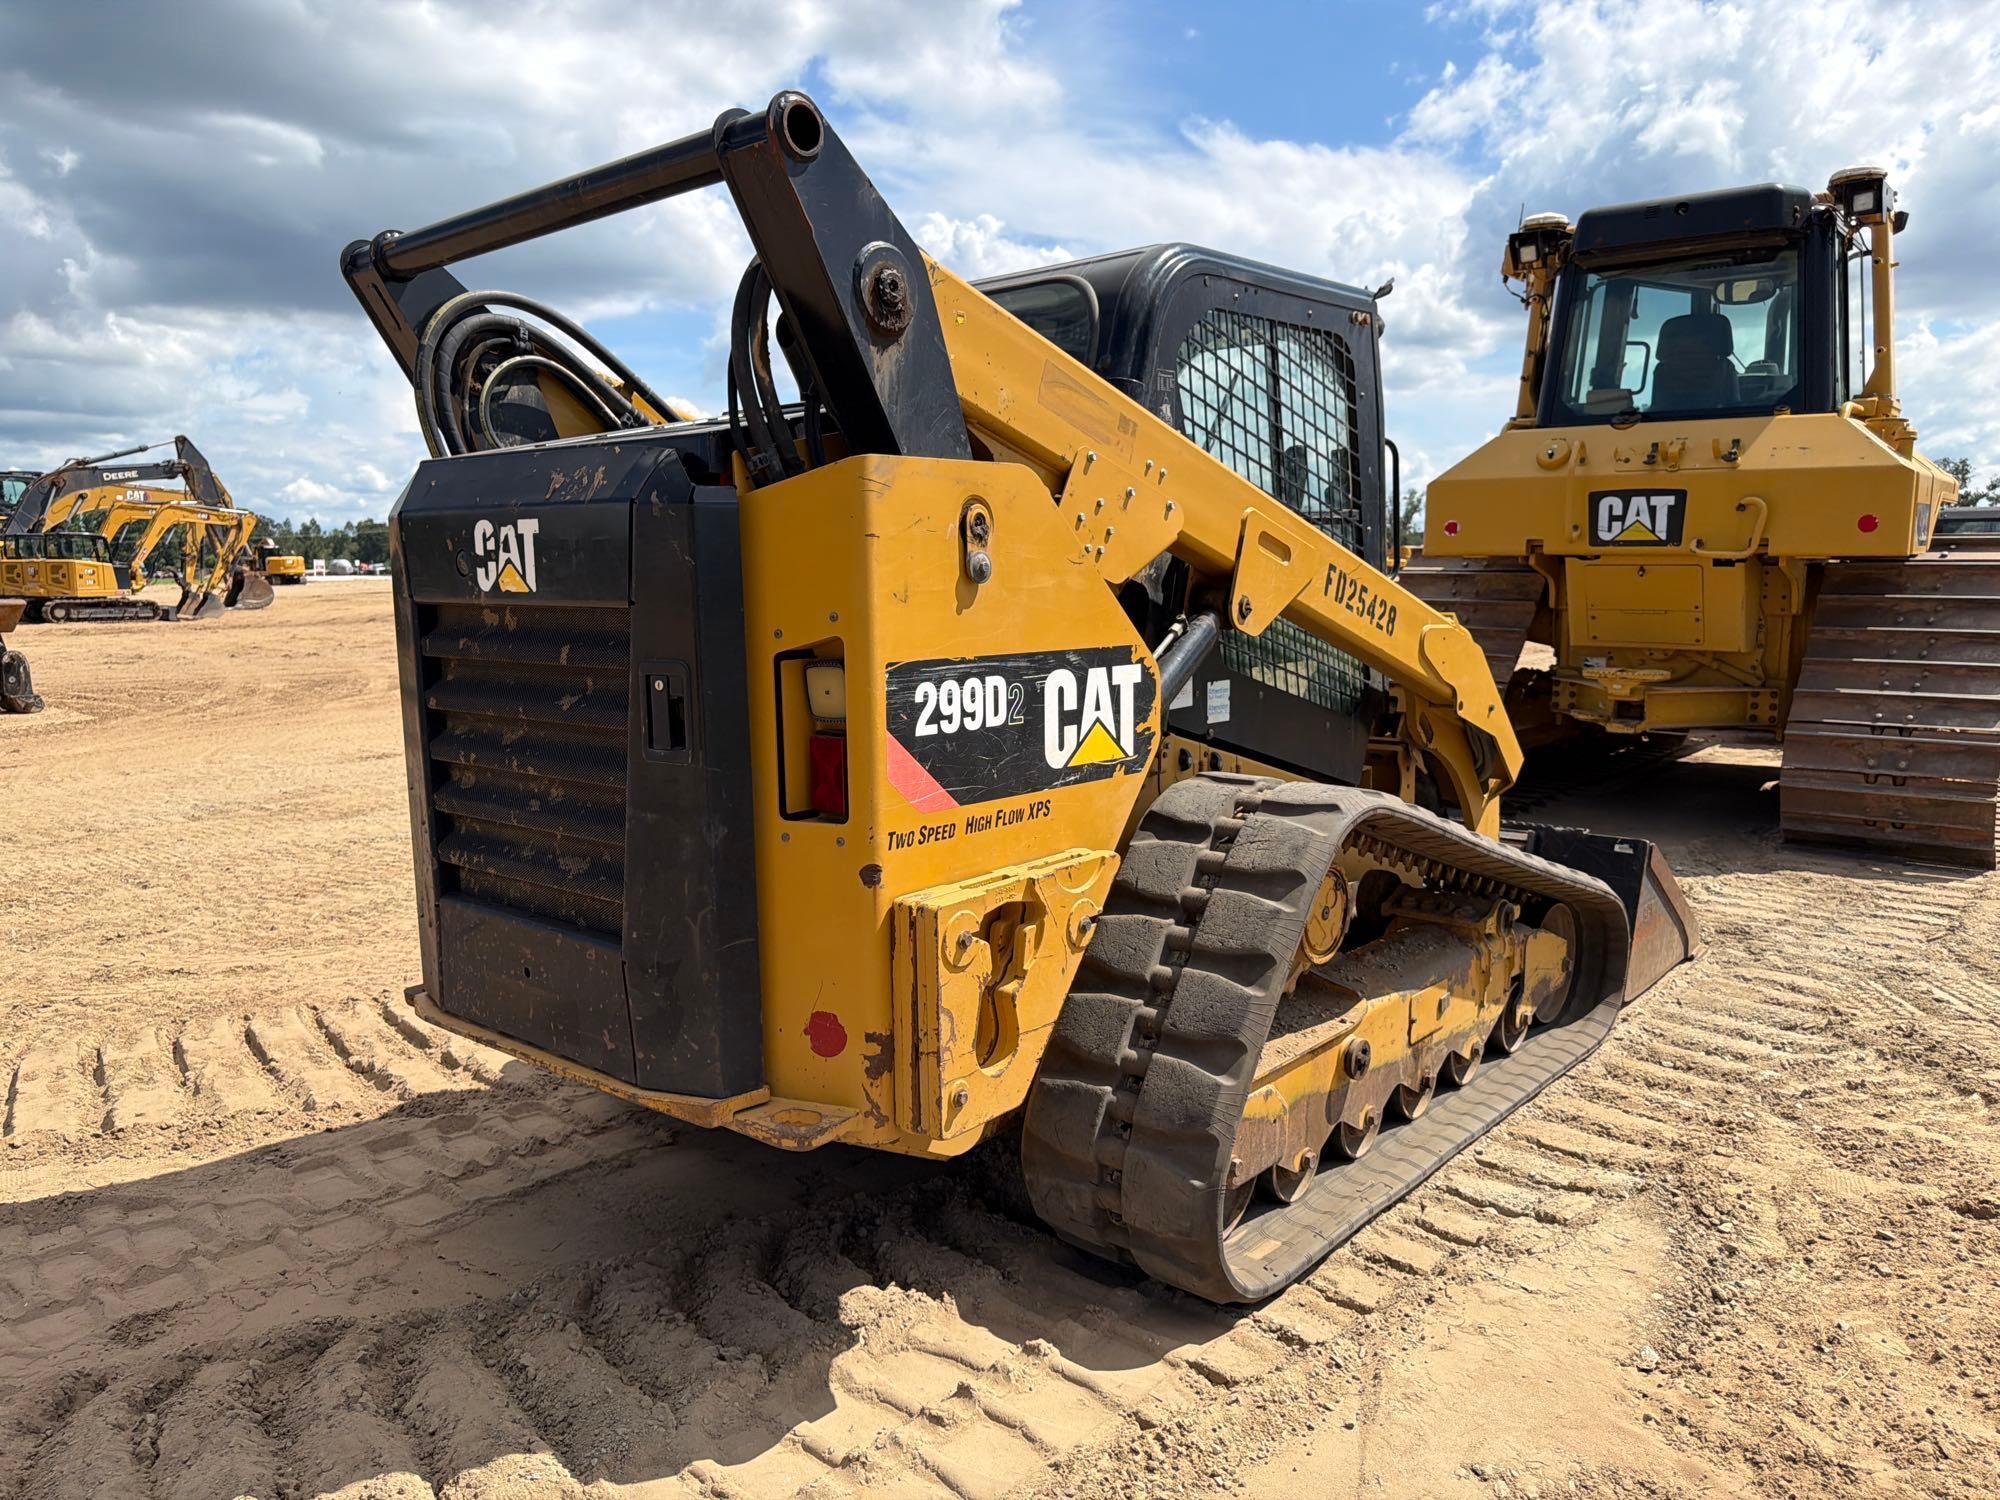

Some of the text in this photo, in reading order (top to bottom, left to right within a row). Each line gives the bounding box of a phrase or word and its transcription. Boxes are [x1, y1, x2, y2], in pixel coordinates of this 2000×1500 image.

[103, 470, 139, 481] DEERE
[126, 490, 145, 502] CAT
[1597, 495, 1676, 541] CAT
[474, 518, 539, 592] CAT
[1324, 563, 1397, 637] FD25428
[1044, 663, 1142, 770] CAT
[1026, 799, 1052, 821] XPS
